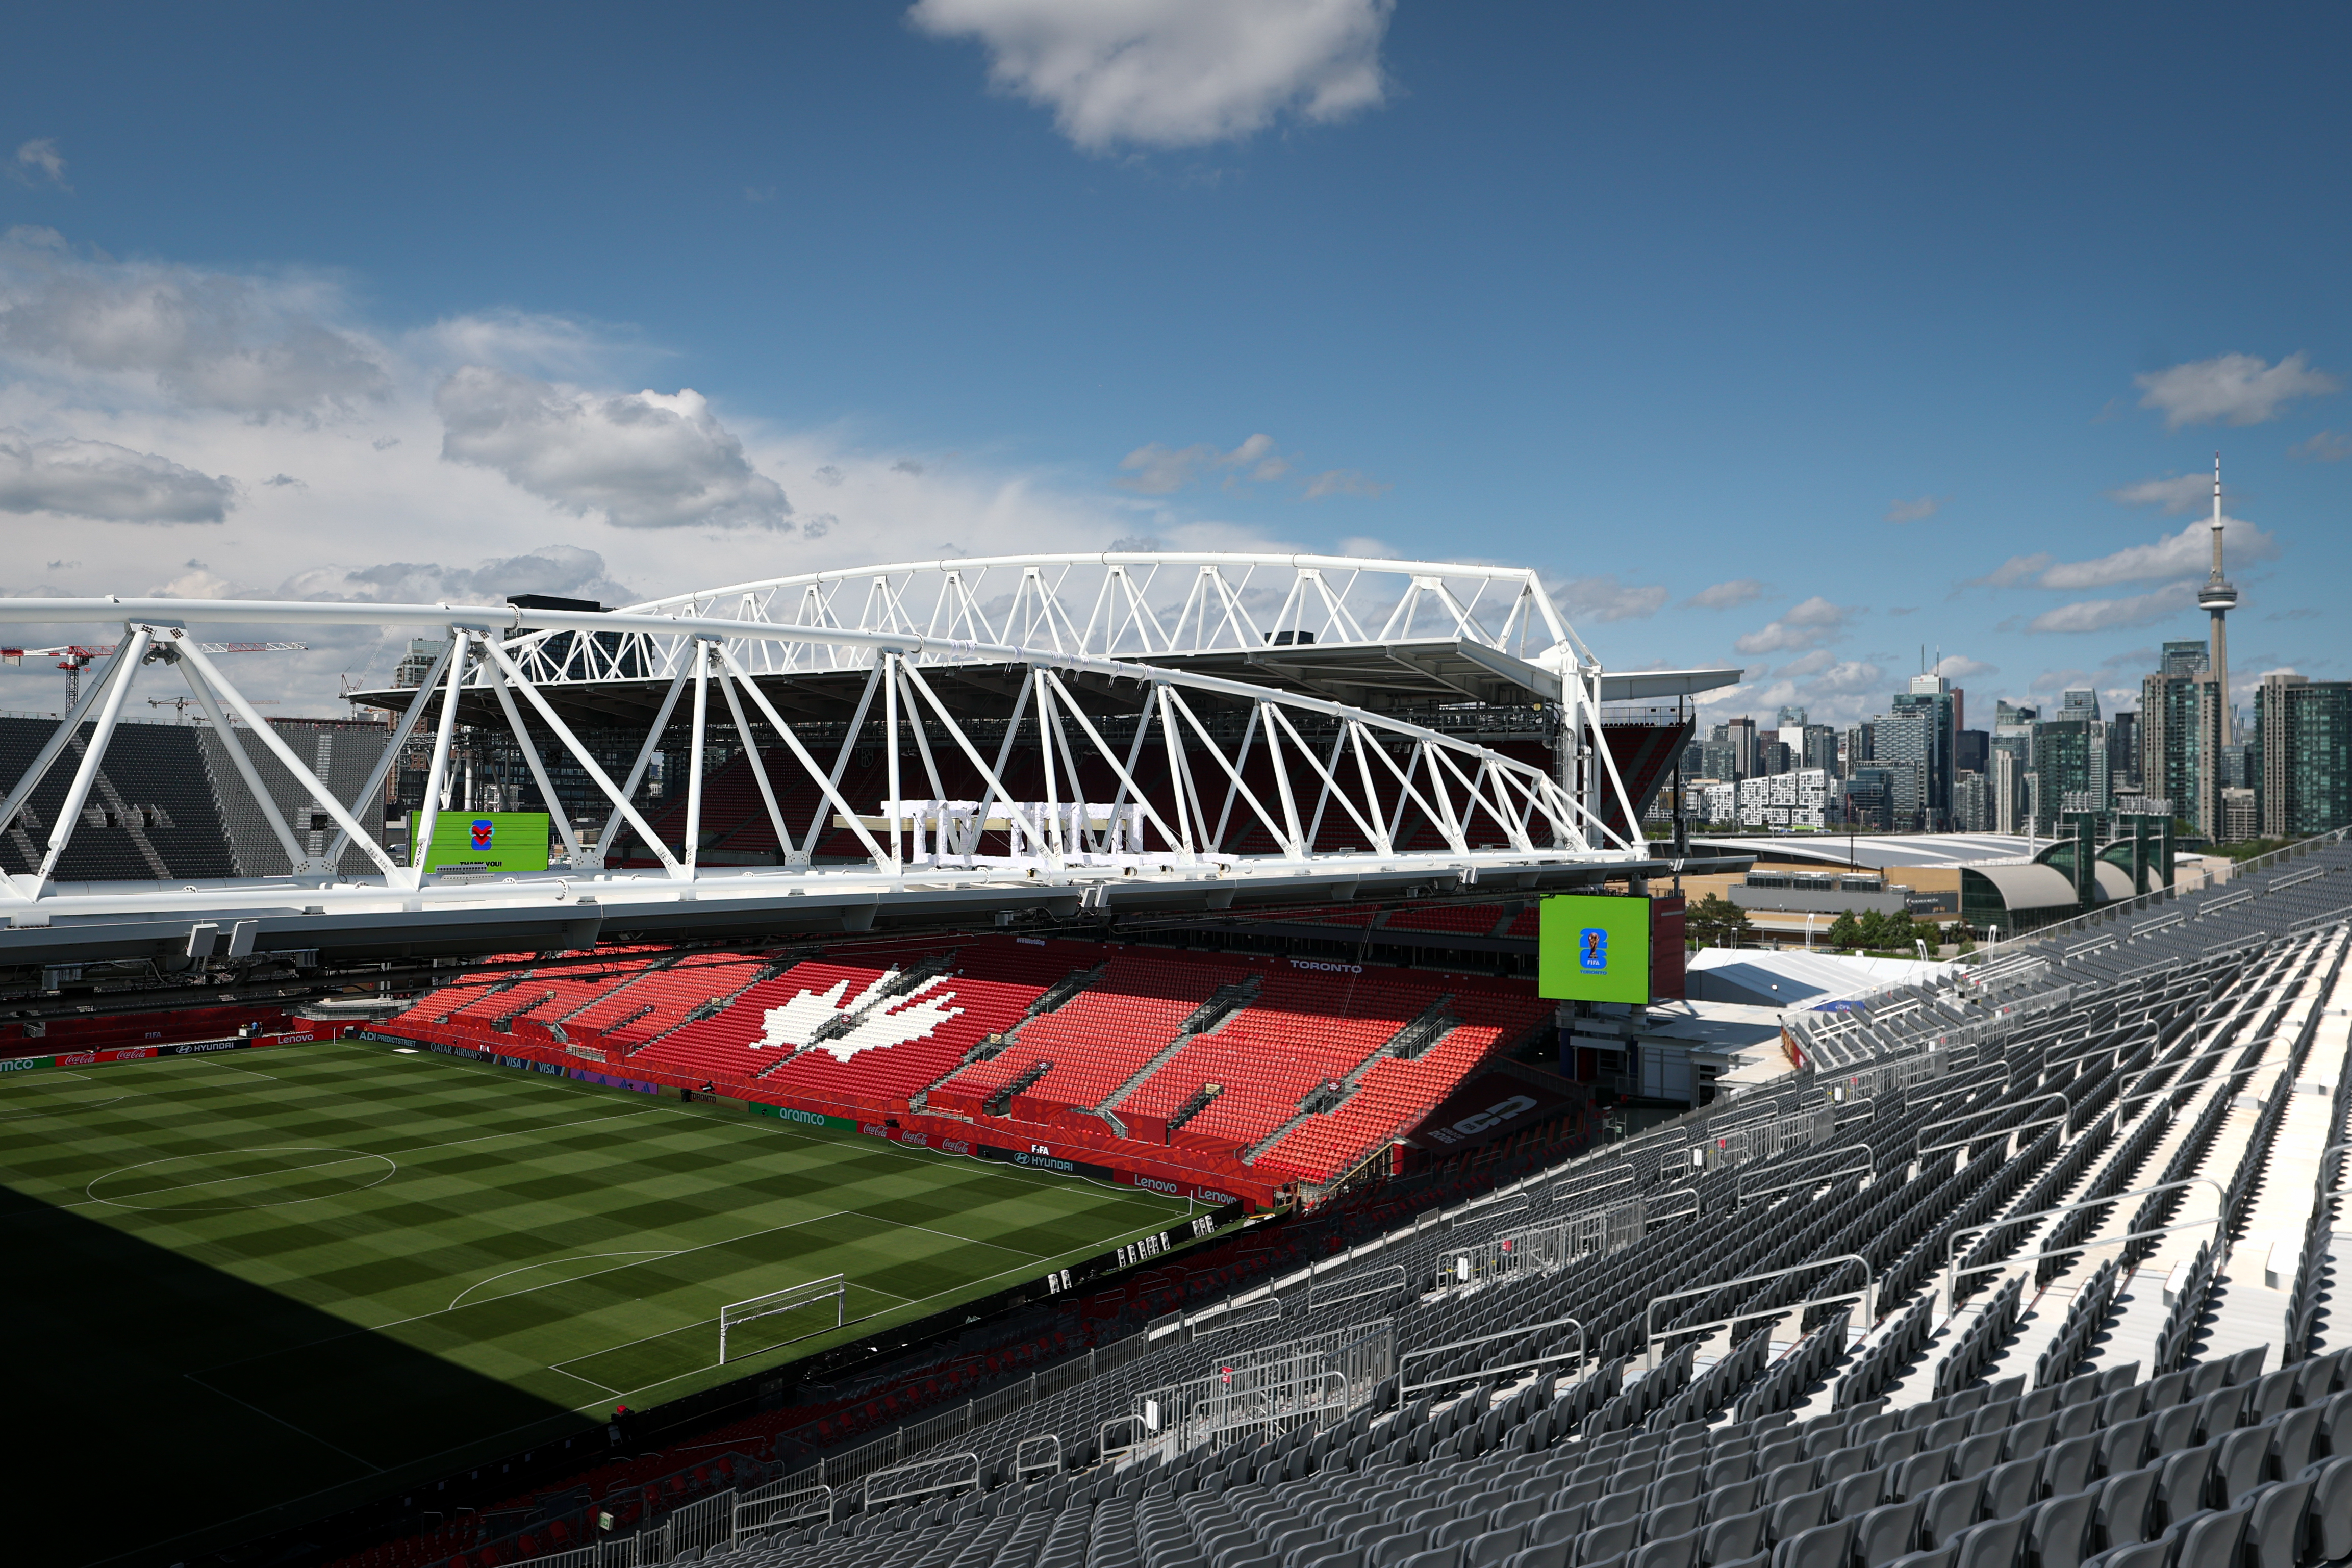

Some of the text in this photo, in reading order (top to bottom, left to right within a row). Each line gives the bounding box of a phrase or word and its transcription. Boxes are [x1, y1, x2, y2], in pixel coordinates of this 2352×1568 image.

[1289, 960, 1362, 973] TORONTO
[277, 1034, 314, 1044] Lenovo
[377, 1034, 416, 1047] PREDICTSTREET
[194, 1042, 234, 1052] HYUNDAI
[430, 1042, 482, 1060] QATAR AIRWAYS
[479, 1044, 490, 1053] FA
[504, 1056, 521, 1069] VISA
[538, 1061, 555, 1075] VISA
[779, 1107, 825, 1126] aramco
[1427, 1130, 1457, 1144] 2026
[1032, 1156, 1073, 1172] HYUNDAI
[1134, 1174, 1177, 1193] Lenovo
[1198, 1186, 1237, 1204] Lenovo
